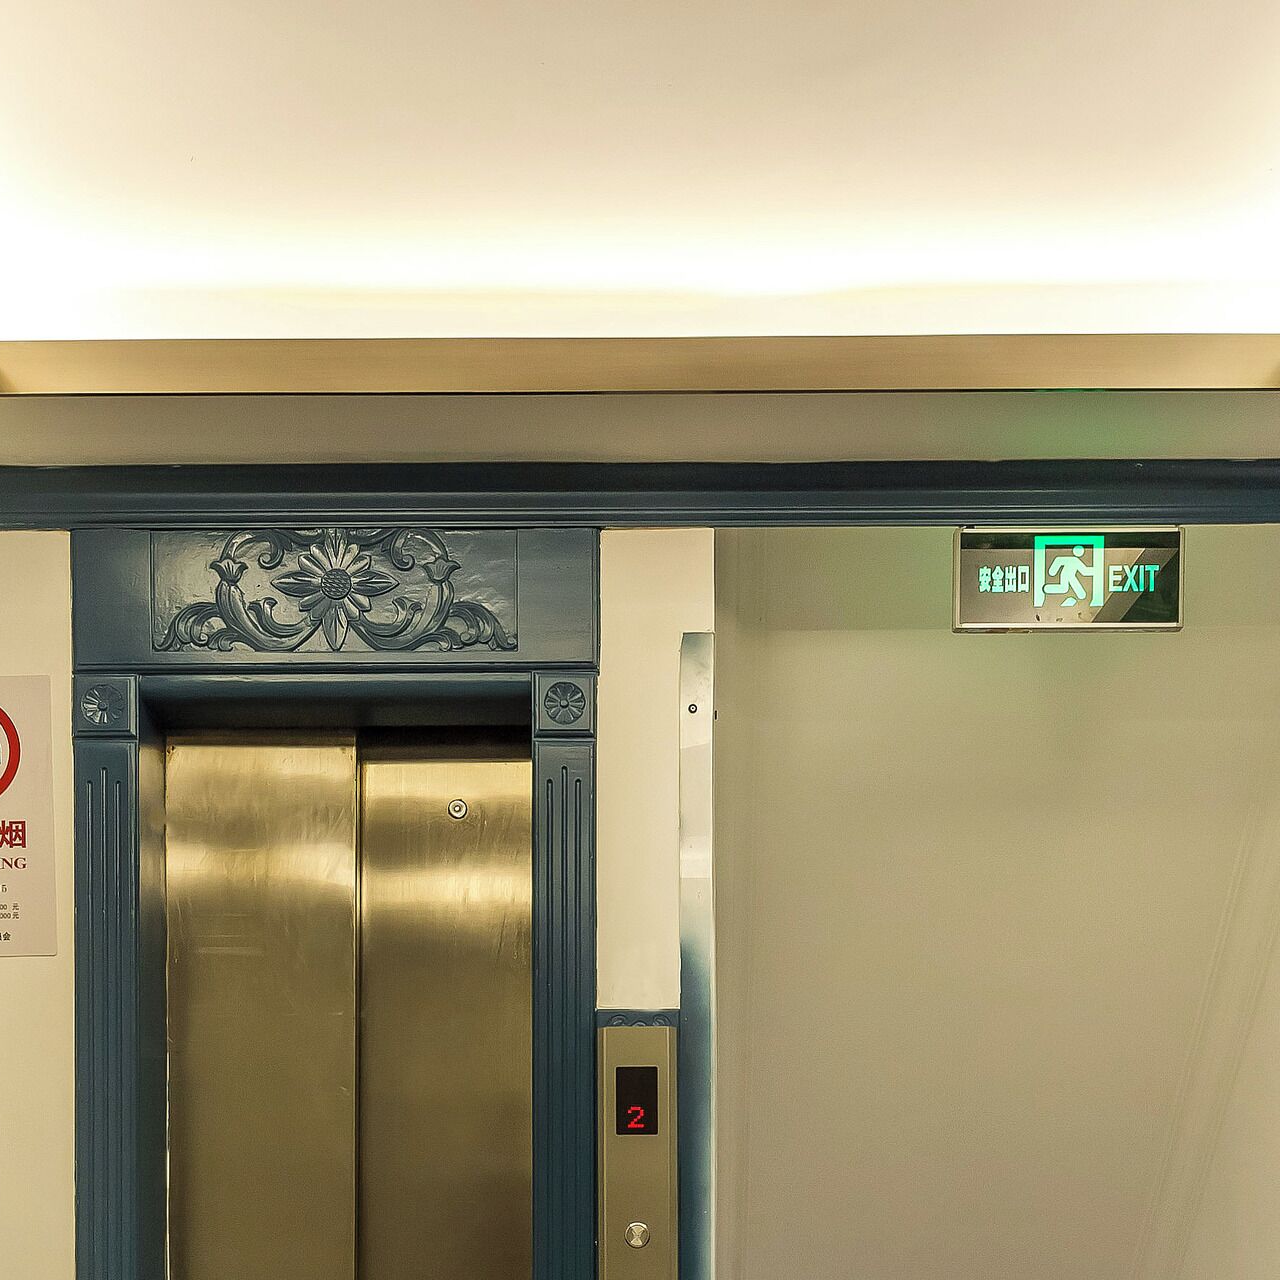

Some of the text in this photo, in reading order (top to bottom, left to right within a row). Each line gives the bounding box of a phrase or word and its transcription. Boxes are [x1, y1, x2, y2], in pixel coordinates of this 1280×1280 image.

[978, 565, 1030, 593] 安全出口
[1108, 565, 1160, 592] EXIT
[627, 1106, 645, 1129] 2
